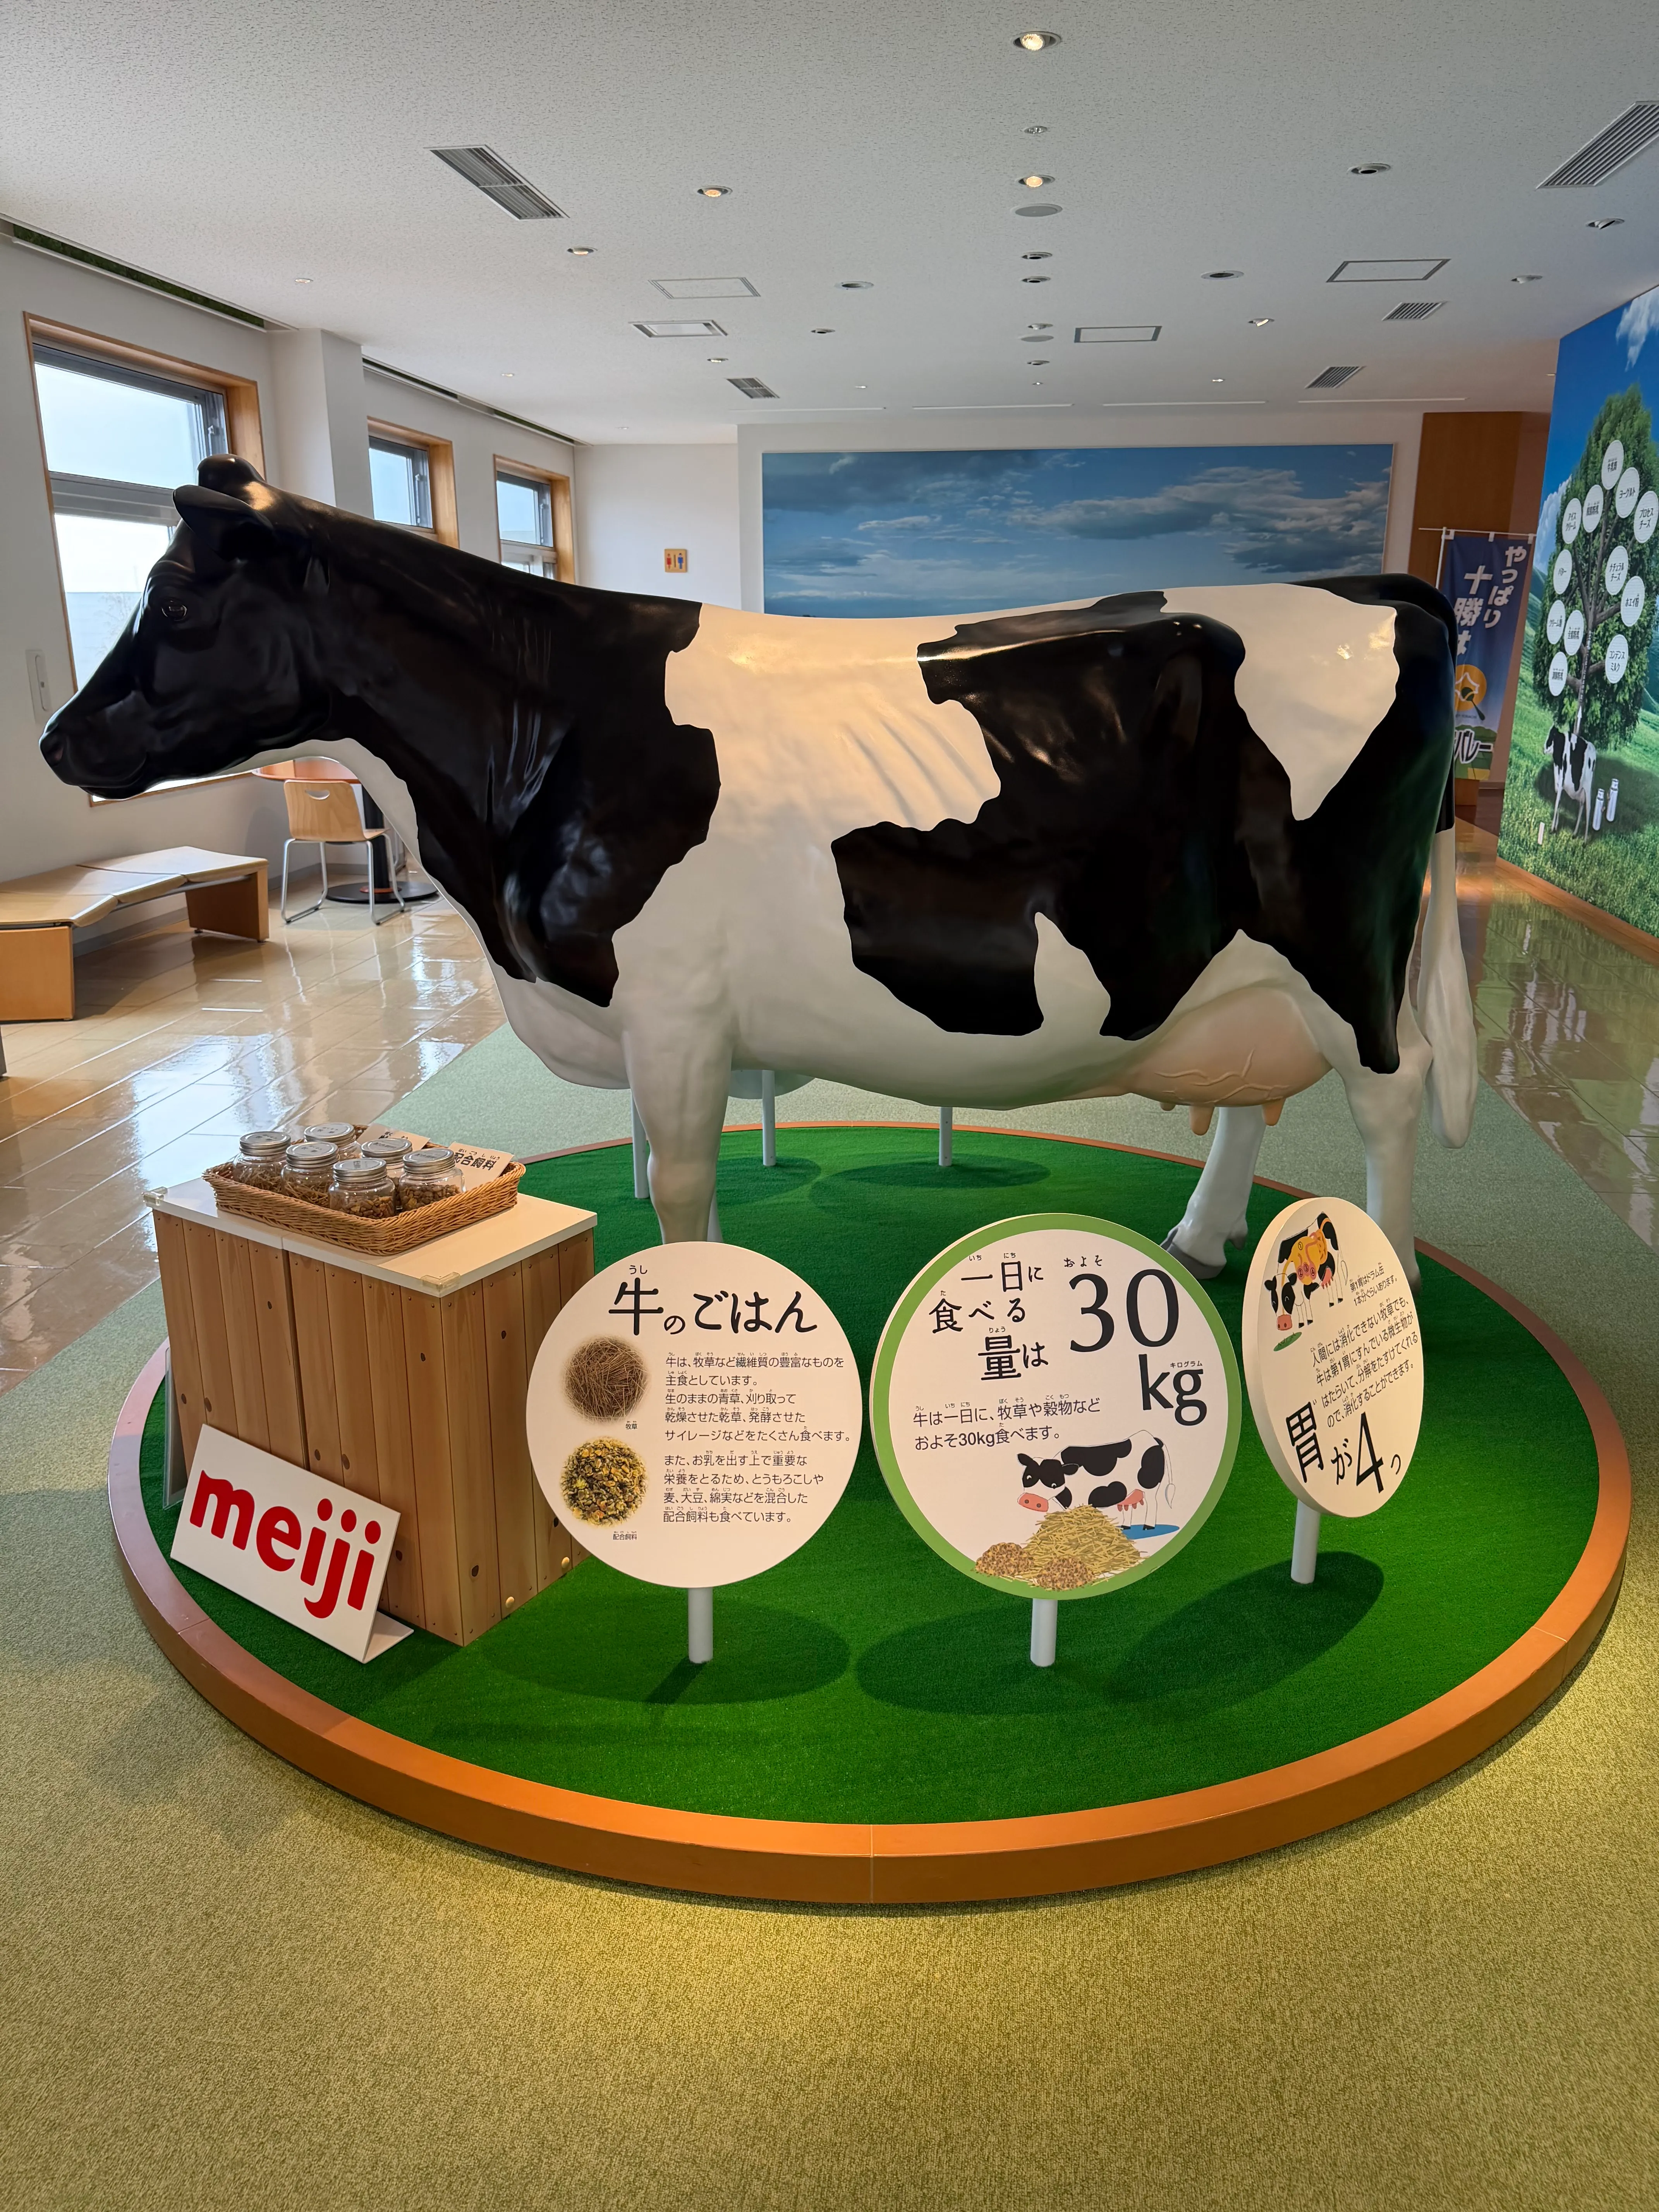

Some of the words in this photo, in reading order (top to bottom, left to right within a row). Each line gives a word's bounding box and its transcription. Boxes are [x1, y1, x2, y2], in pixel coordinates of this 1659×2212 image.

[1483, 546, 1527, 629] やっぱり
[629, 1265, 648, 1275] うし
[1064, 1255, 1103, 1267] およそ
[961, 1261, 1044, 1292] 一日に
[608, 1277, 817, 1336] 牛のごはん
[929, 1298, 1026, 1334] 食べる
[1069, 1269, 1179, 1352] 30
[1312, 1297, 1409, 1367] 人間には消化できない牧草でも、
[666, 1357, 844, 1368] 牛は、牧草など繊維質の豊富なものを
[978, 1335, 1049, 1381] 量は
[1317, 1311, 1413, 1386] 牛は第1胃にすんでいる微生物が
[666, 1375, 757, 1386] 主食としています。
[1321, 1331, 1418, 1408] はたらいて、分解をたすけてくれる
[665, 1393, 796, 1404] 生のままの青草、刈り取って
[1139, 1354, 1207, 1426] kg
[1327, 1359, 1413, 1428] ので、消化することができます。
[665, 1412, 805, 1423] 乾燥させた乾草、発酵させた
[913, 1398, 1100, 1427] 牛は一日に、牧草や穀物など
[665, 1430, 849, 1441] サイレージなどをたくさん食べます。
[915, 1425, 1060, 1451] およそ30kg食べます。
[1286, 1401, 1401, 1494] 胃が4つ
[665, 1455, 807, 1466] また、お乳を出す上で重要な
[664, 1473, 823, 1485] 栄養をとるため、とうもろこしや
[664, 1492, 807, 1504] 麦、大豆、綿実などを混合した
[663, 1511, 790, 1523] 配合飼料も食べています。
[190, 1469, 382, 1620] meiji
